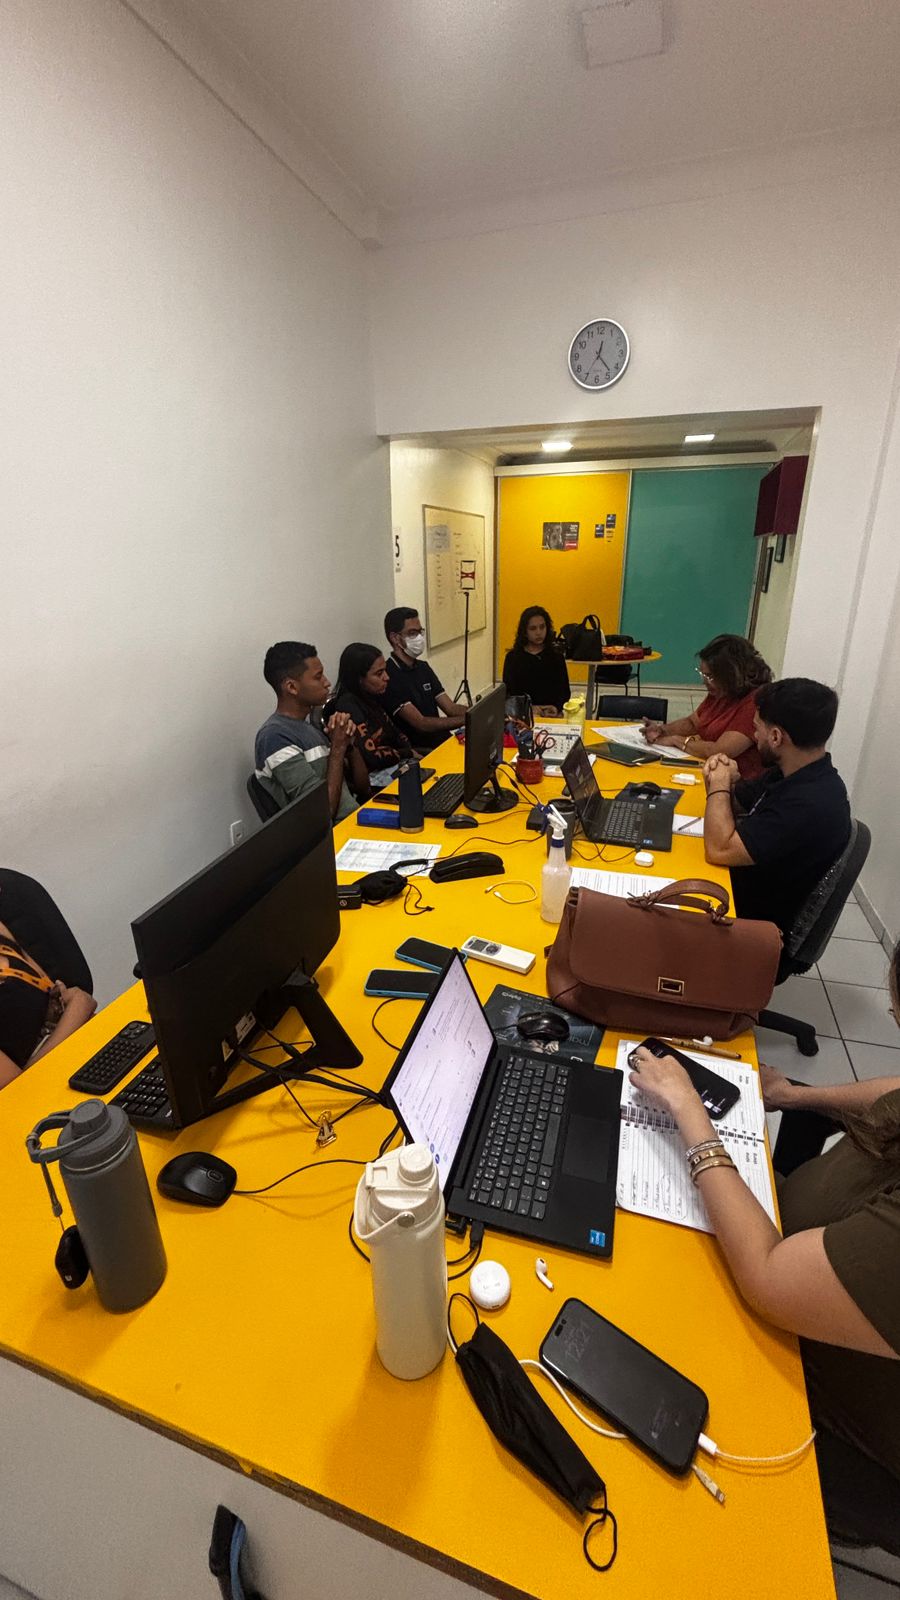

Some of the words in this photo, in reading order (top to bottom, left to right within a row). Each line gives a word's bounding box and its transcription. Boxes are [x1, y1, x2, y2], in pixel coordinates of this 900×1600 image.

[587, 331, 594, 339] 11
[597, 326, 605, 335] 12
[610, 329, 613, 337] 1
[579, 341, 586, 349] 10
[574, 352, 580, 361] 9
[618, 349, 624, 358] 3
[576, 365, 582, 373] 8
[584, 372, 589, 382] 7
[594, 375, 600, 384] 6
[605, 372, 610, 380] 5
[395, 535, 400, 557] 5
